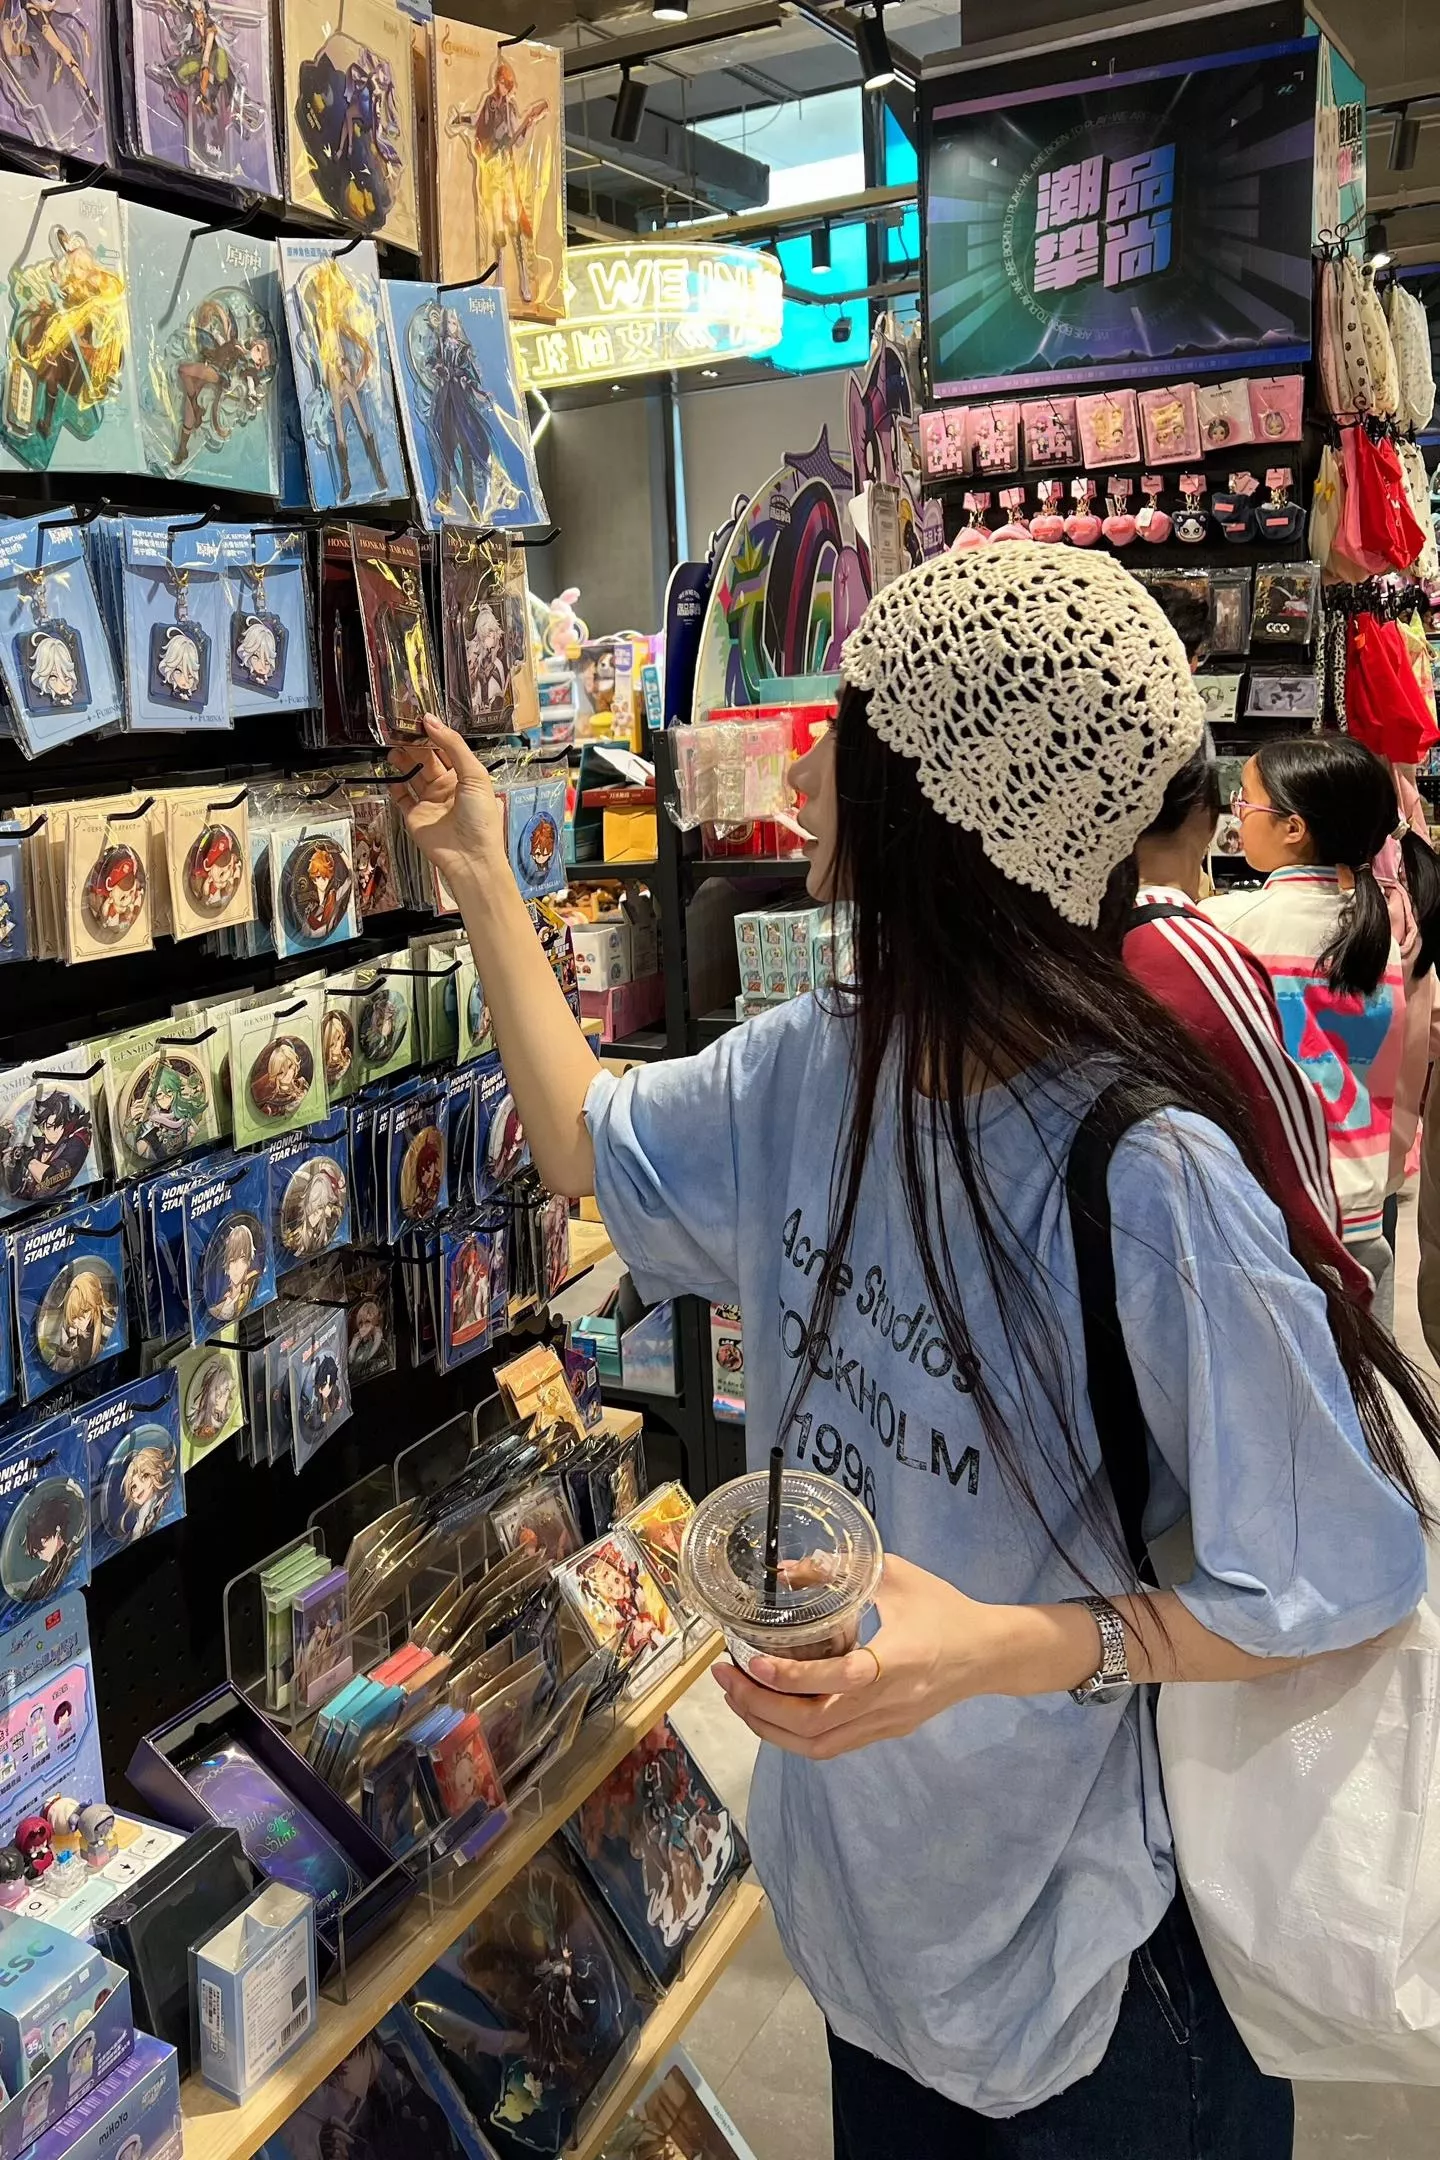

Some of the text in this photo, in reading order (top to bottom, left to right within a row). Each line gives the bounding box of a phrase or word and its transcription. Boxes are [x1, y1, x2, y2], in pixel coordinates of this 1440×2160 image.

[270, 1131, 302, 1153] HONKAI
[270, 1146, 289, 1164] STAR
[190, 1181, 225, 1207] HONKAI
[190, 1189, 232, 1220] STAR RAIL
[23, 1233, 75, 1266] STAR RAIL
[24, 1225, 67, 1253] HONKAI
[782, 1207, 853, 1297] Acne
[856, 1264, 981, 1394] Studios
[780, 1300, 981, 1496] OCKHOLM
[87, 1410, 134, 1443] STAR RAIL
[88, 1400, 128, 1430] HONKAI
[13, 1467, 38, 1490] RAIL
[98, 2110, 129, 2146] miHoYo
